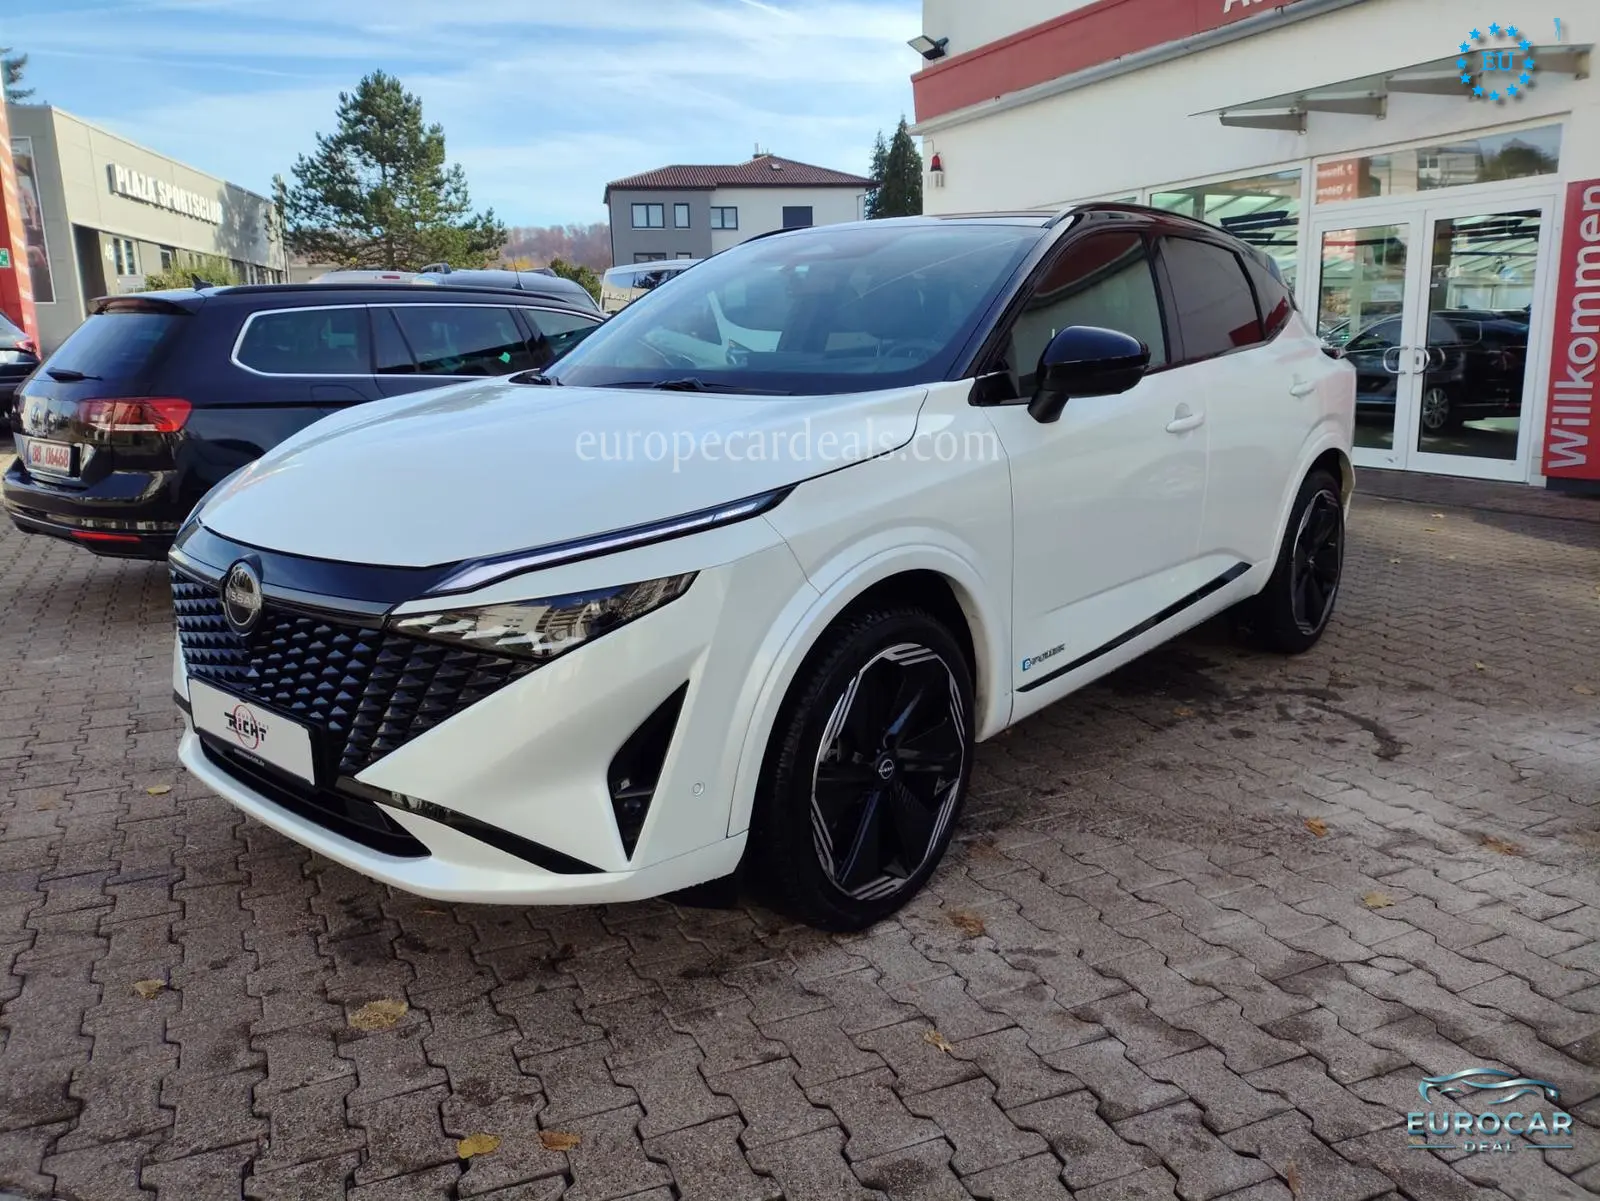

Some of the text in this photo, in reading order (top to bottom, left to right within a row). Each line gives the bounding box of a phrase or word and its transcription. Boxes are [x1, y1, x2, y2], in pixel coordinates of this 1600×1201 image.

[115, 163, 224, 226] PLAZA SPORTSCLUB
[1547, 184, 1600, 469] Willkommen
